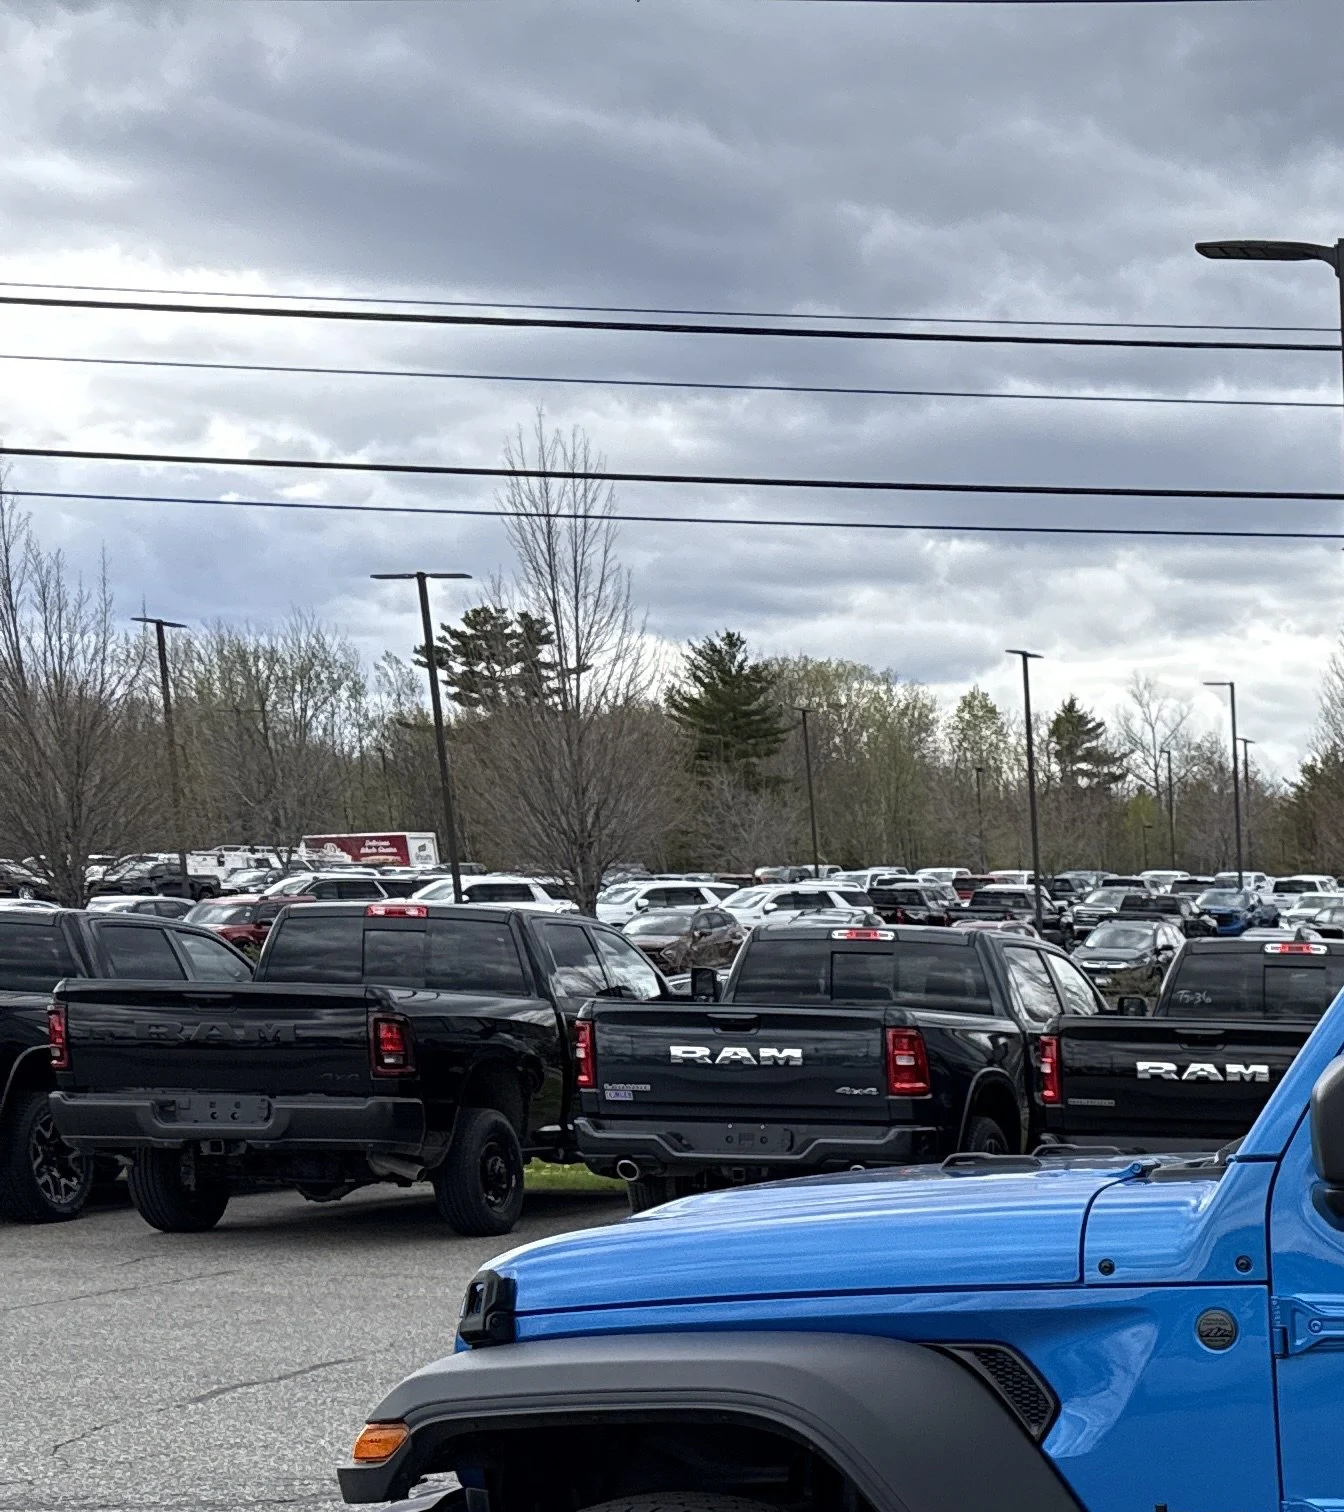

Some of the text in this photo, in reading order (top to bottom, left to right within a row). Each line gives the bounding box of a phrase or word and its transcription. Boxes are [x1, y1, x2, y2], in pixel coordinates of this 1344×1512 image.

[134, 1020, 297, 1042] RAM
[669, 1046, 803, 1065] RAM
[1136, 1061, 1270, 1082] RAM
